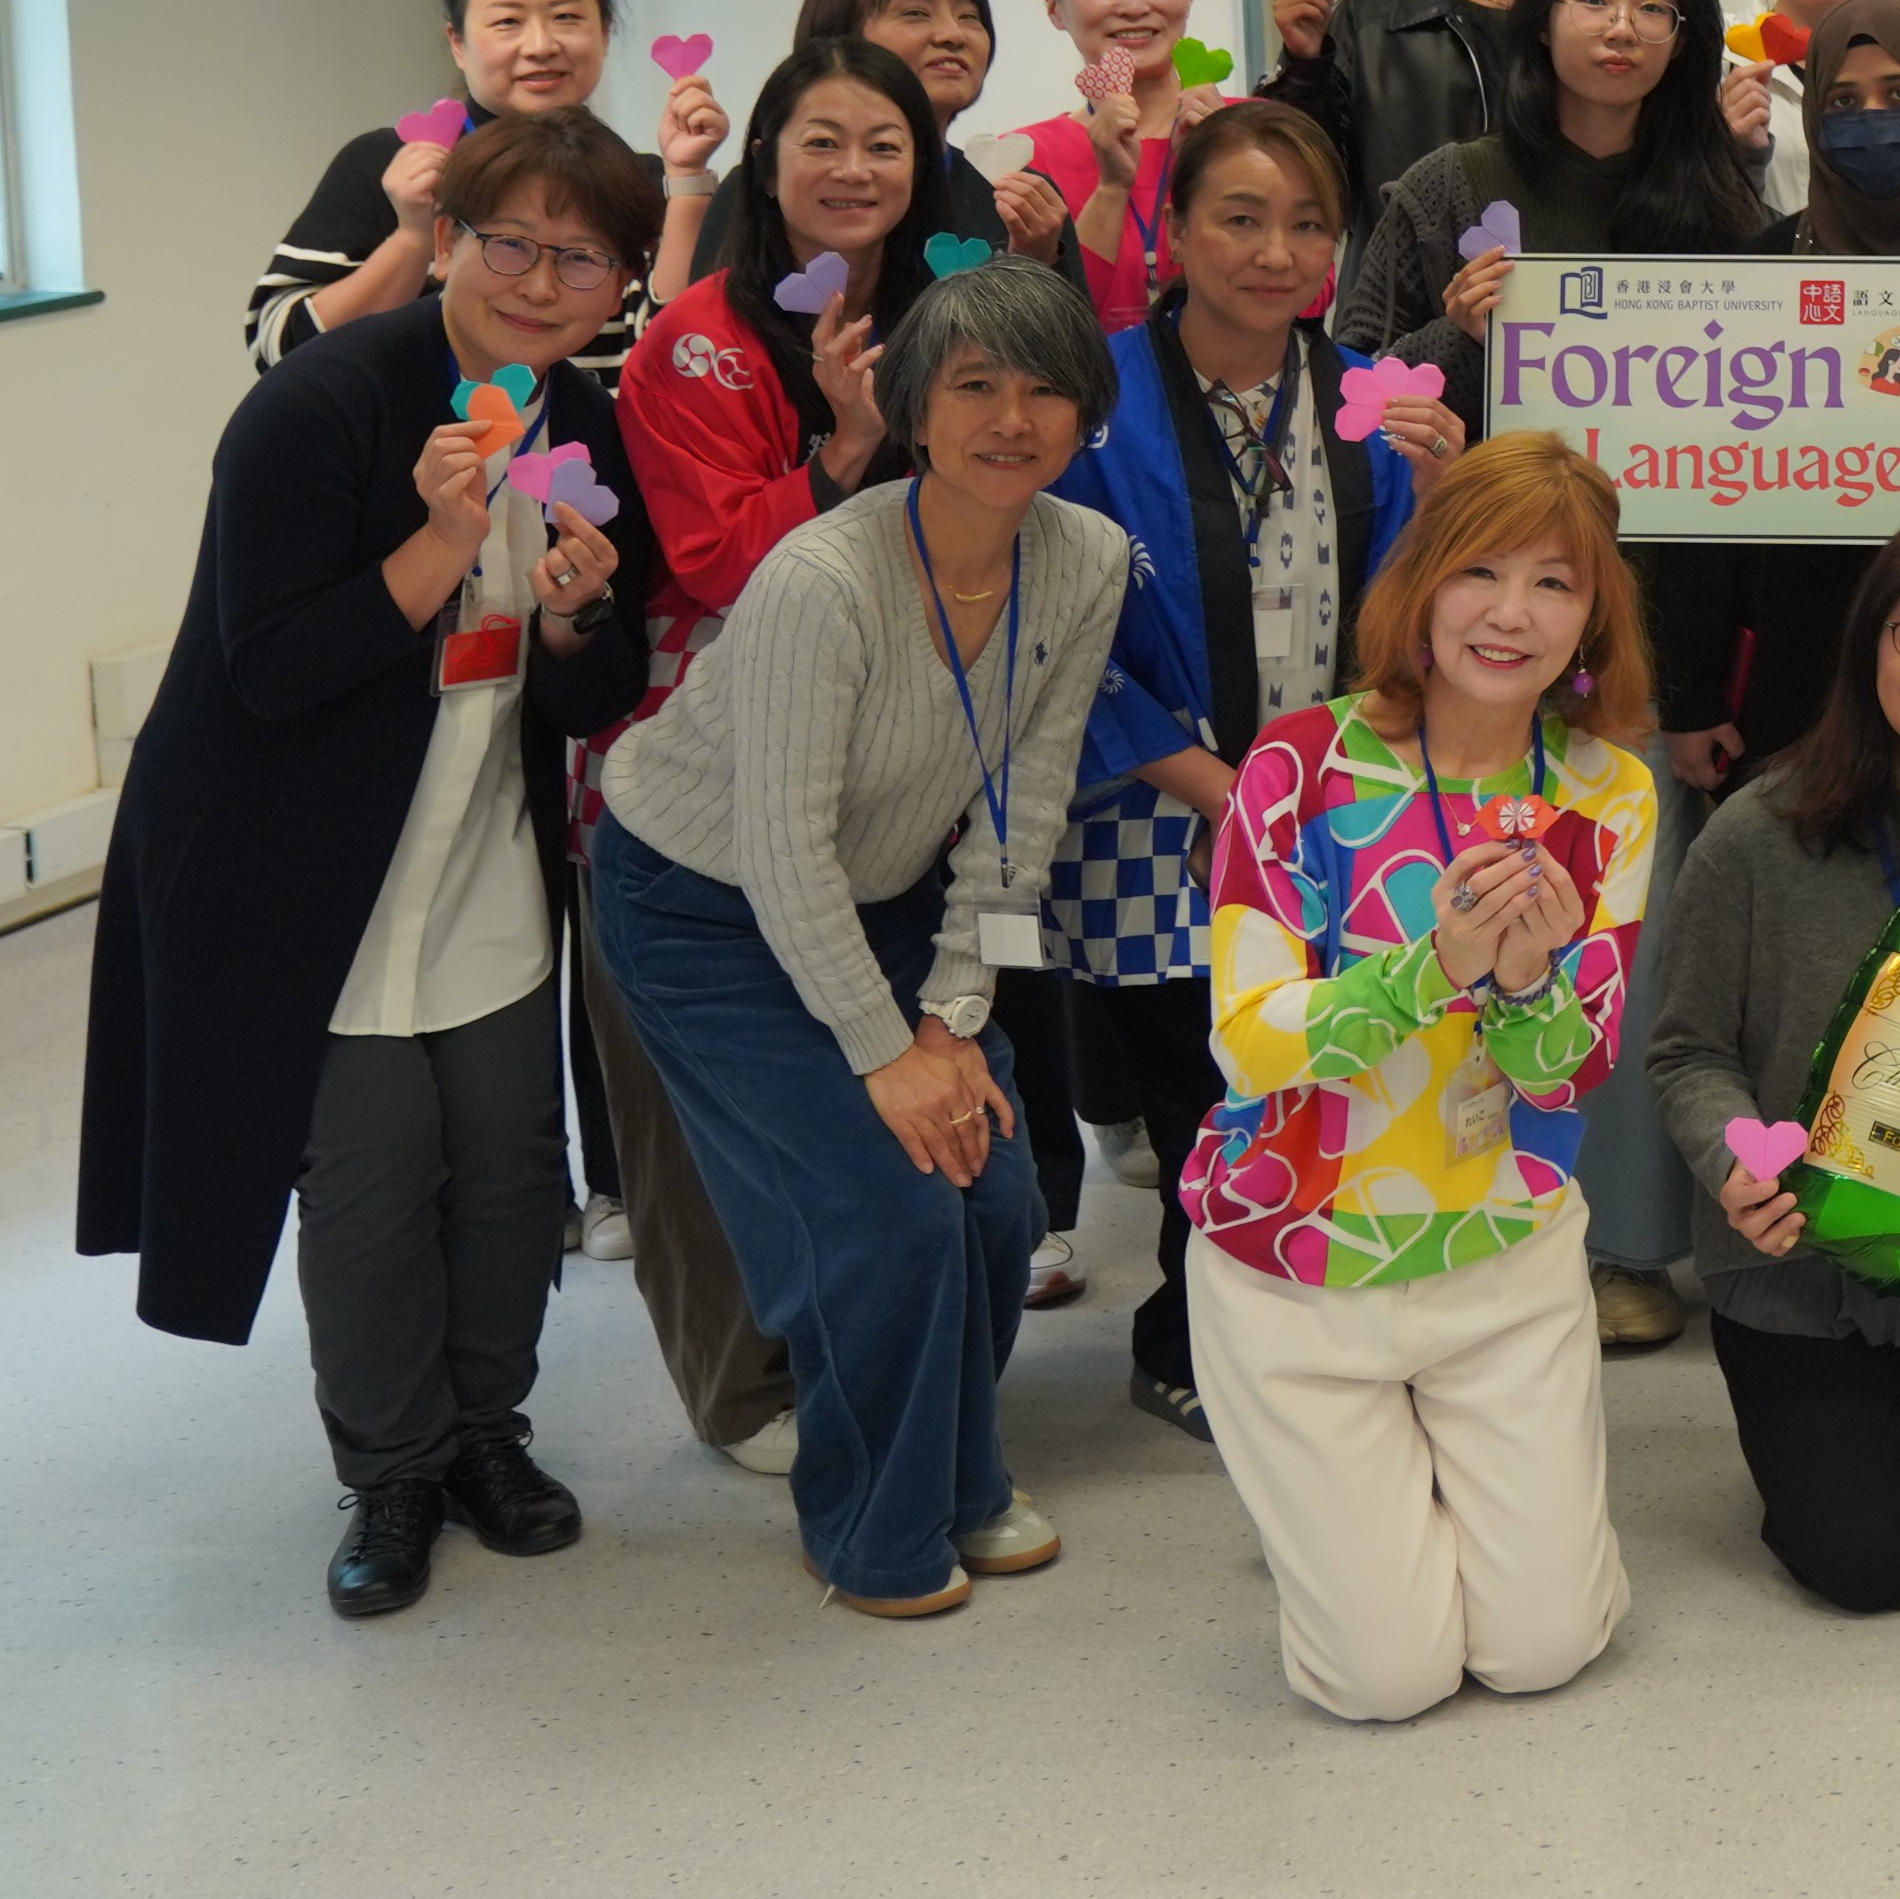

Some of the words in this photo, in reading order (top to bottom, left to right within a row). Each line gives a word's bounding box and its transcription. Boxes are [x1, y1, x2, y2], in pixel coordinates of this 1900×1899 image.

[1616, 279, 1736, 295] 香港浸會大學
[1614, 299, 1643, 311] HONG
[1646, 299, 1674, 311] KONG
[1677, 300, 1720, 311] BAPTIST
[1723, 300, 1784, 312] UNIVERSITY
[1500, 319, 1845, 431] Foreign
